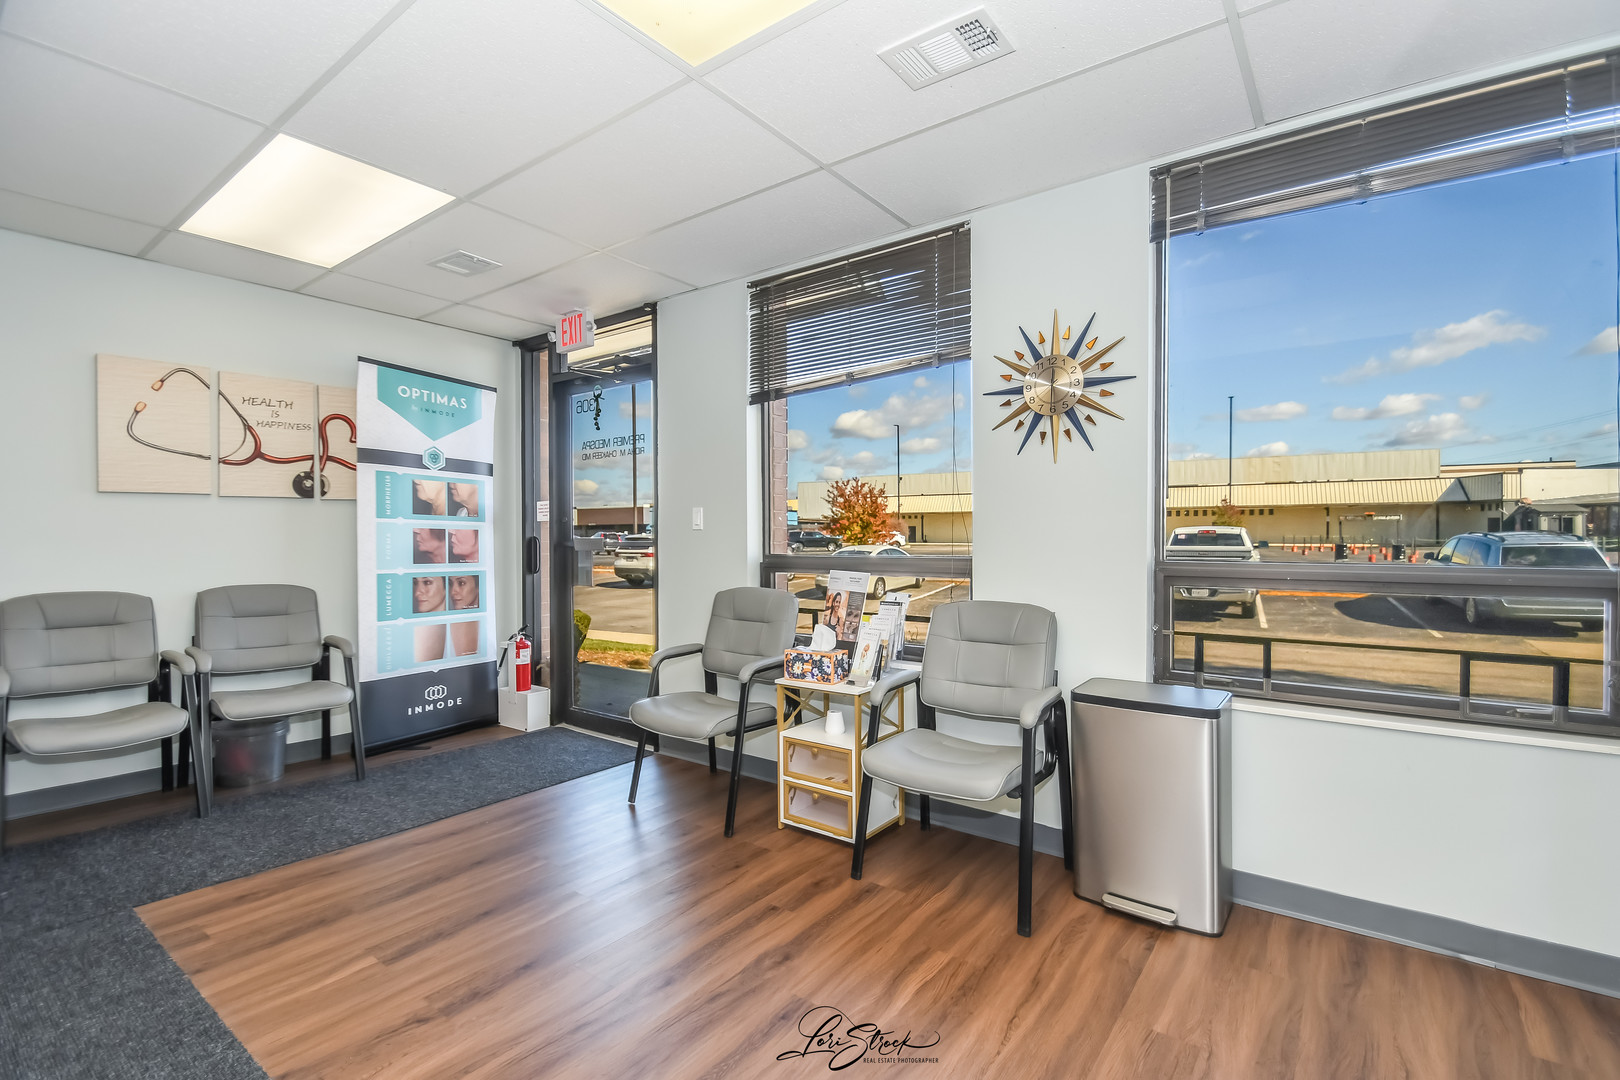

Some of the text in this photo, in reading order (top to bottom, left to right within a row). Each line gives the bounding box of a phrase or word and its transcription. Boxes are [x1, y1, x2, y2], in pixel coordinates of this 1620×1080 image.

[562, 313, 583, 347] EXIT
[1047, 356, 1057, 365] 12
[1036, 362, 1044, 370] 11
[1070, 366, 1077, 374] 2
[1028, 372, 1037, 380] 10
[1074, 378, 1080, 386] 3
[397, 385, 468, 409] OPTIMAS
[1029, 396, 1036, 404] 8
[242, 396, 293, 410] HEALTH
[1062, 401, 1069, 409] 5
[1038, 404, 1044, 412] 7
[1050, 405, 1056, 413] 6
[271, 410, 280, 418] IS
[420, 407, 455, 418] INMODE
[256, 420, 312, 431] HAPPINESS
[408, 697, 462, 715] INMODE
